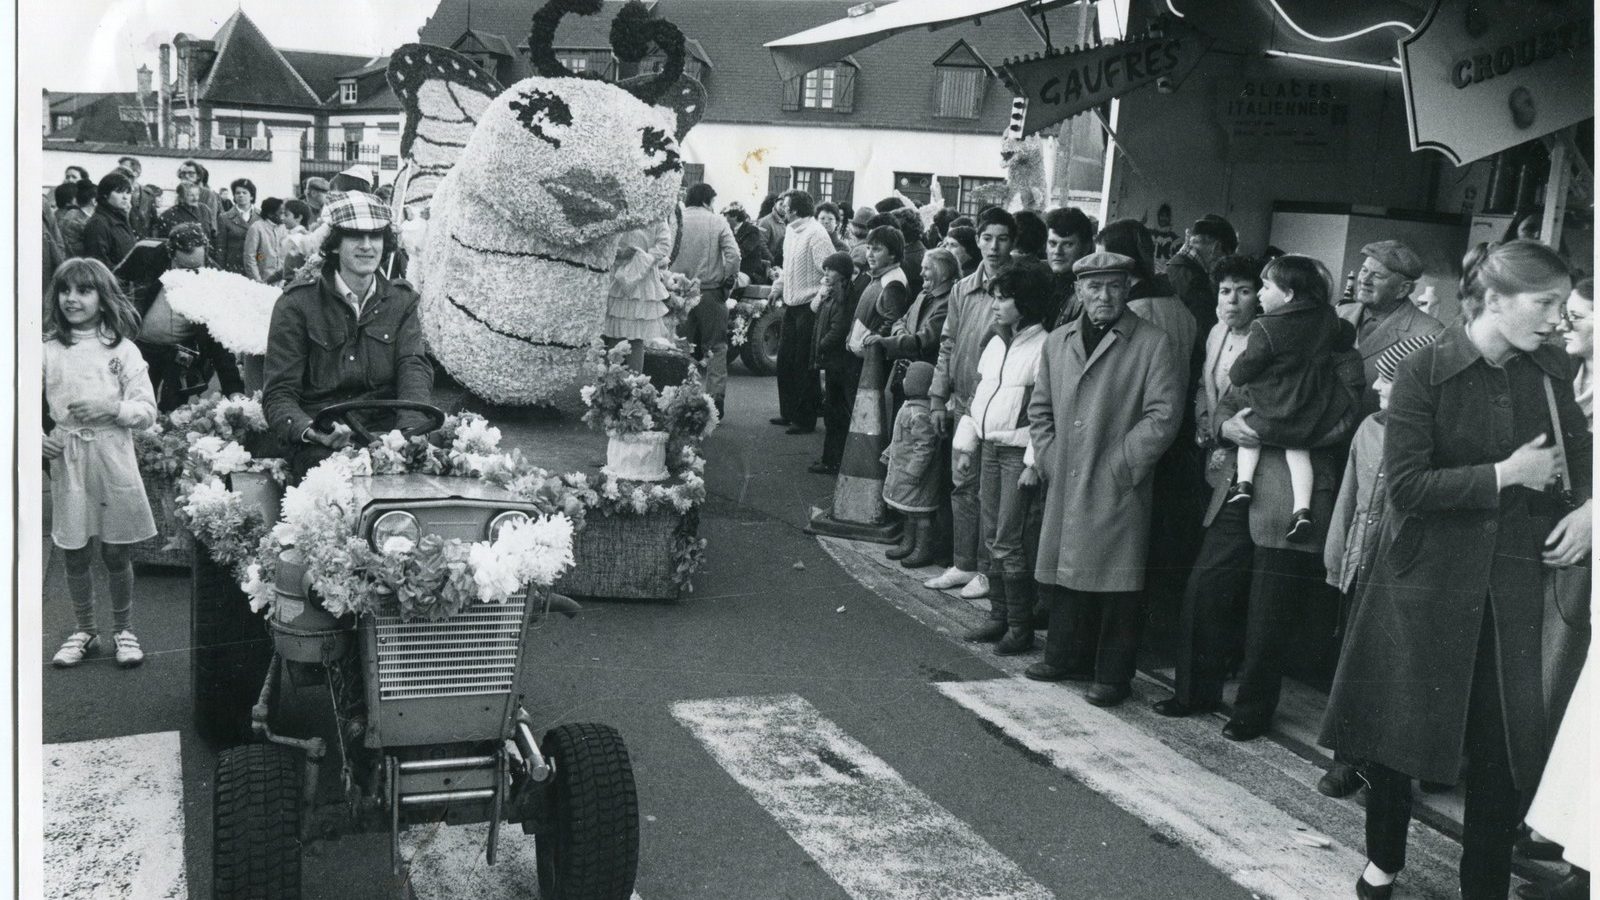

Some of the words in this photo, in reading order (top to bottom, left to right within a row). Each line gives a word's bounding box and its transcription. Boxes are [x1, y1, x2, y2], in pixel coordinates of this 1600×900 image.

[1040, 40, 1182, 105] GAUFRES
[1244, 81, 1332, 98] GLACES
[1228, 101, 1329, 116] ITALIENNES
